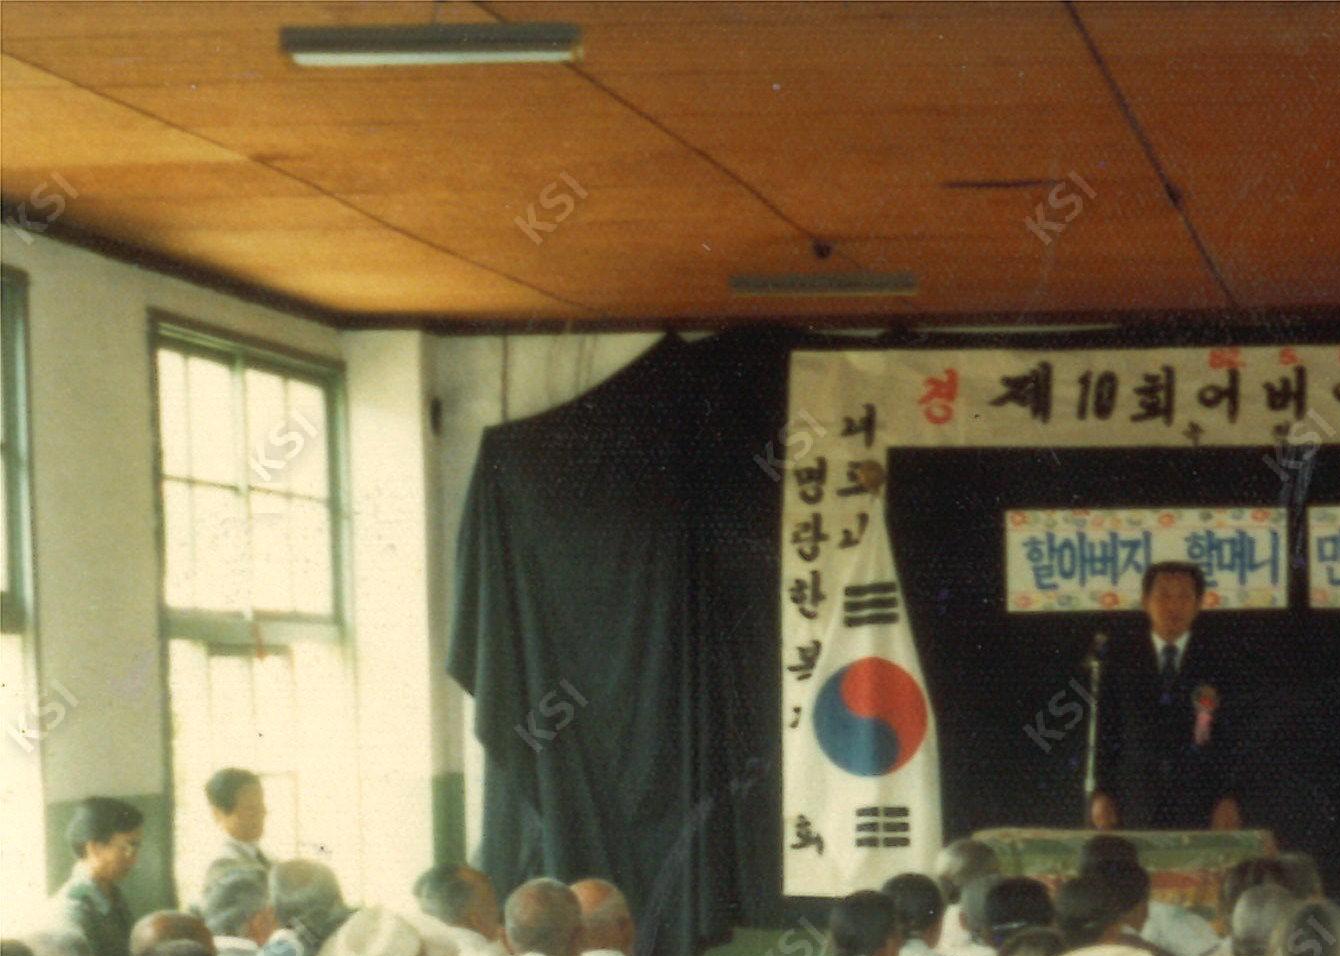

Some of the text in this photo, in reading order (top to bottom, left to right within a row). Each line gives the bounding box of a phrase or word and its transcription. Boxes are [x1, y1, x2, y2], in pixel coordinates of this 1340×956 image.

[918, 368, 960, 425] 경
[1021, 526, 1281, 591] 할아버지 할머니
